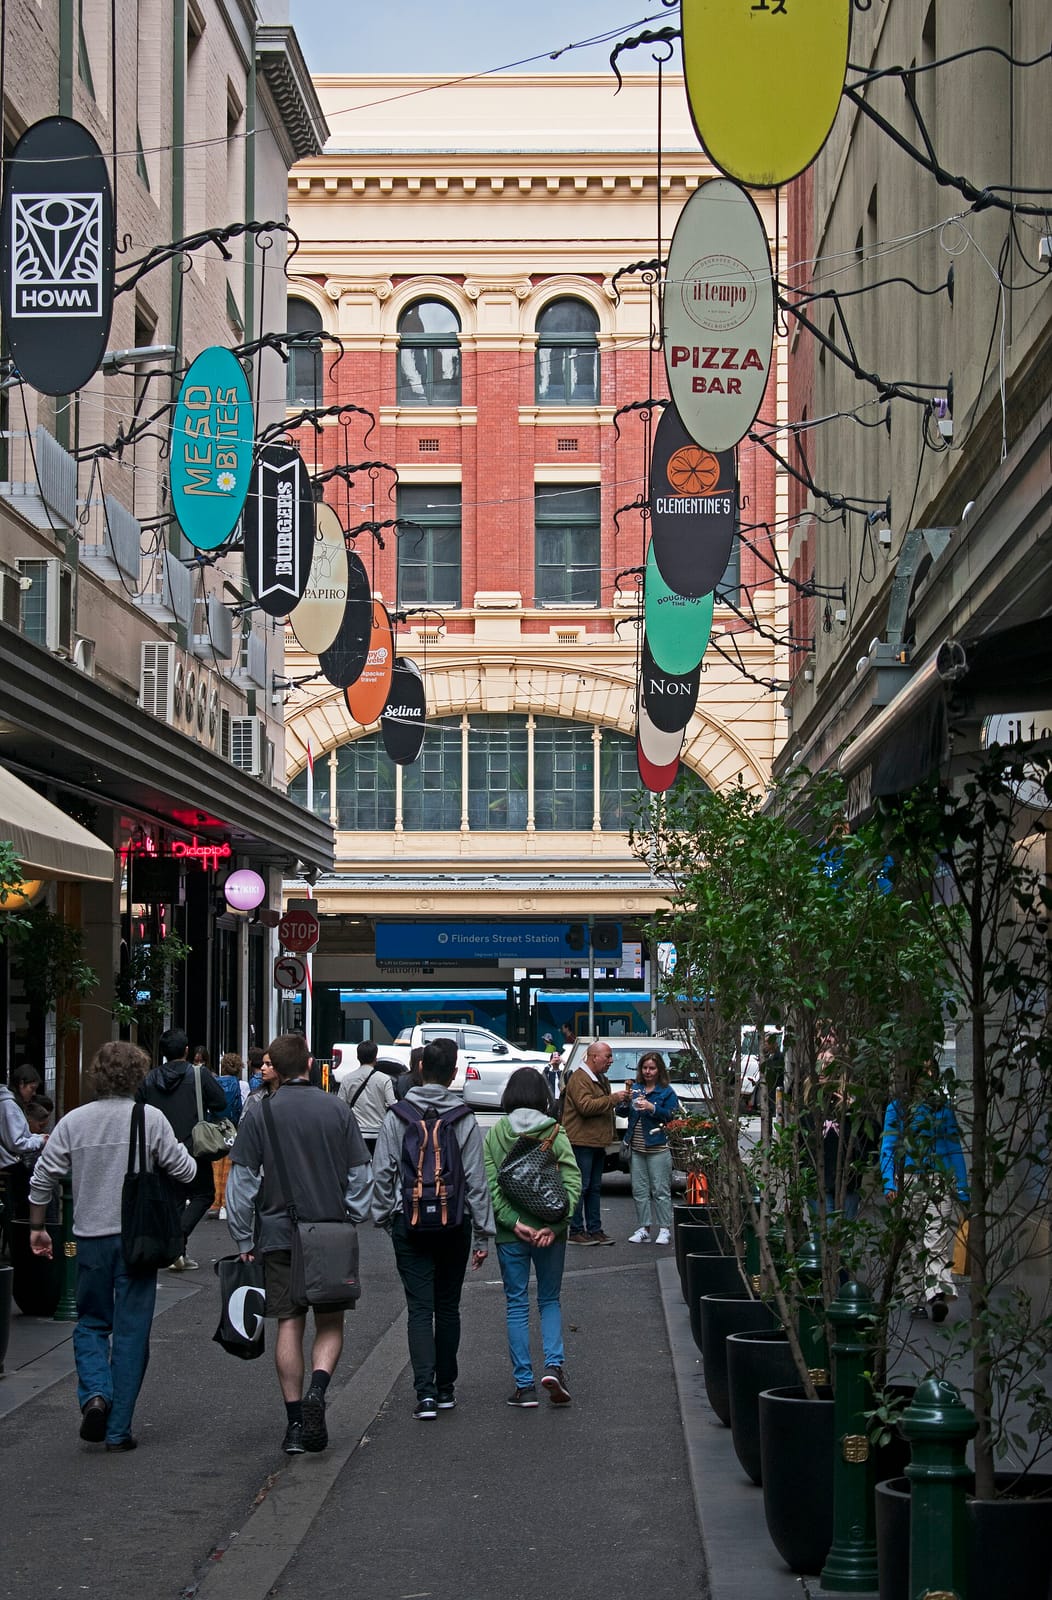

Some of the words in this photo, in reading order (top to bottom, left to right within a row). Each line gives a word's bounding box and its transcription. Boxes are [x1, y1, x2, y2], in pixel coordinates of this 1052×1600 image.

[22, 290, 92, 307] HOWM
[705, 281, 747, 308] tempo
[671, 346, 764, 371] PIZZA
[692, 376, 742, 394] BAR
[215, 386, 239, 470] BITES
[182, 385, 237, 498] MESO
[656, 498, 731, 514] CLEMENTINE'S
[275, 481, 293, 575] BURGERS
[304, 588, 346, 600] PAPIRO
[384, 704, 421, 717] Selina
[281, 923, 317, 939] STOP
[451, 934, 490, 943] Flinders
[492, 934, 522, 943] Street
[524, 934, 560, 943] Station
